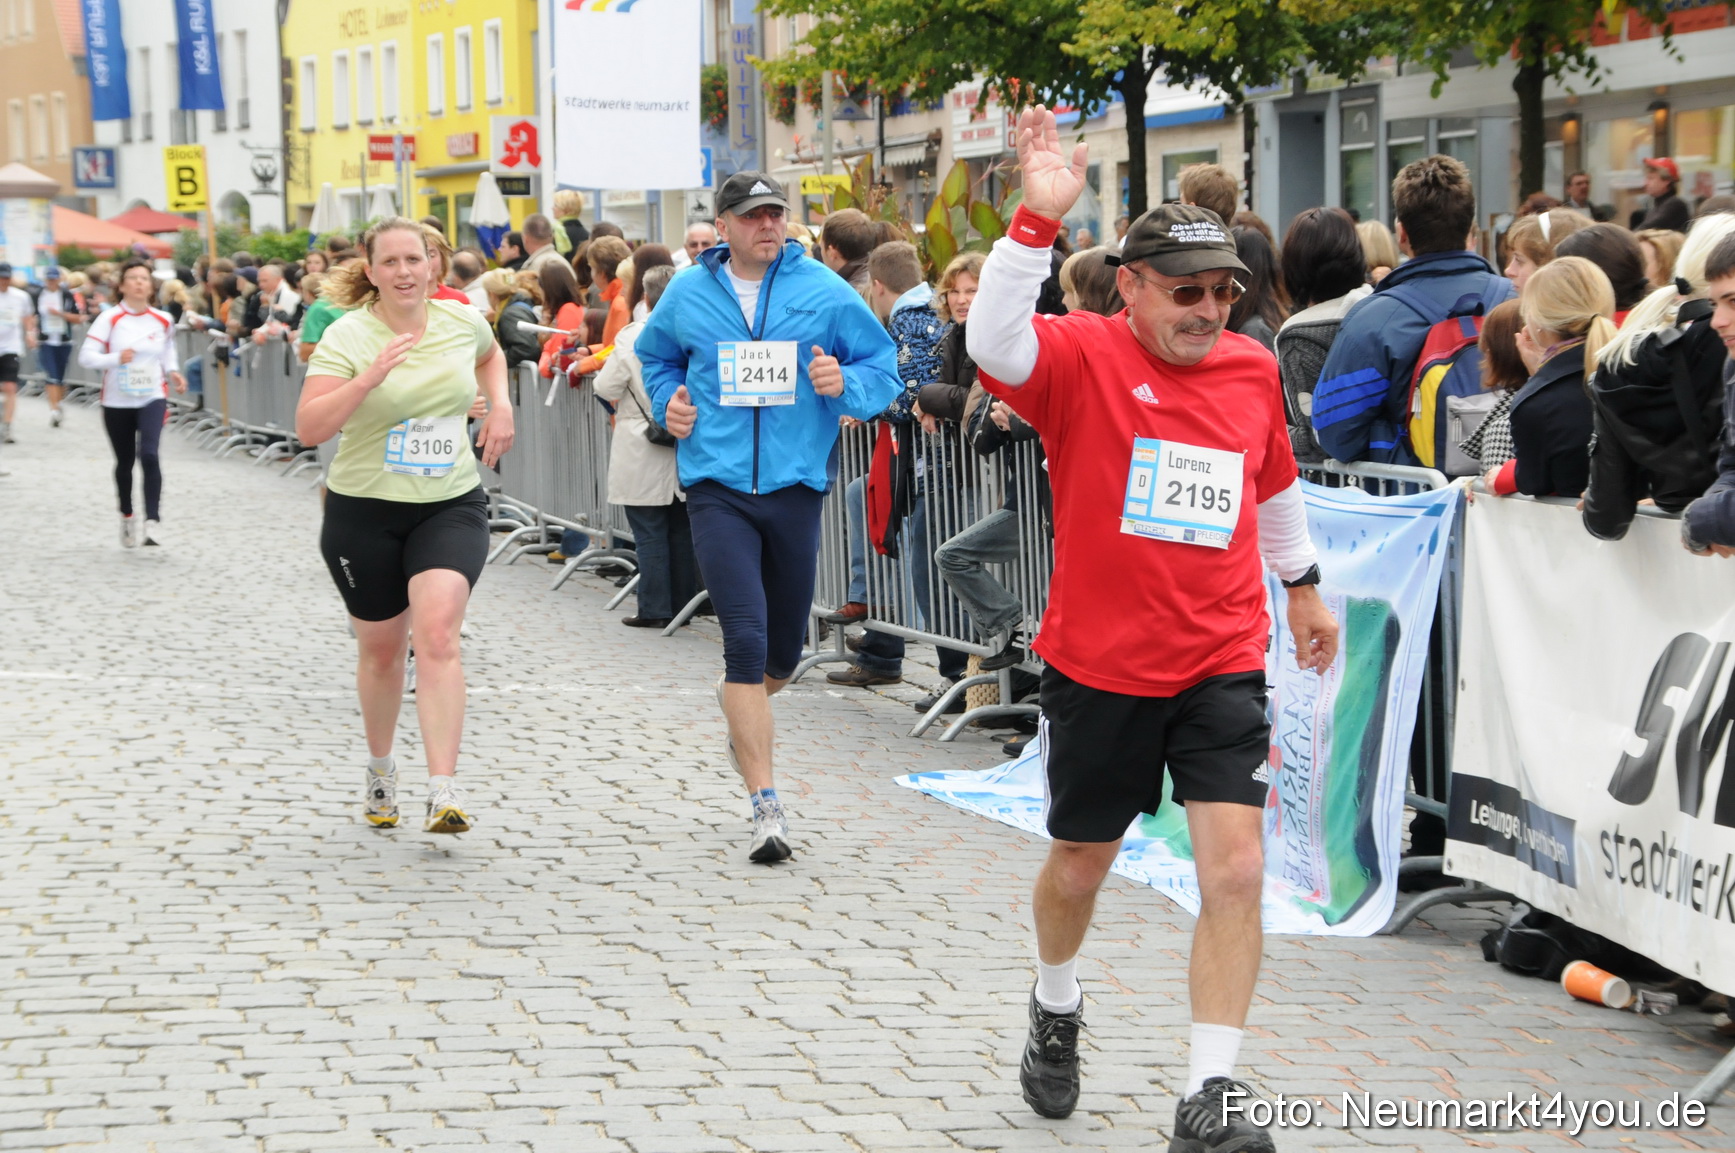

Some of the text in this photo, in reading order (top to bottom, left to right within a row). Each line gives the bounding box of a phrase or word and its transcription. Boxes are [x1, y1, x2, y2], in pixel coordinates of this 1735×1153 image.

[564, 96, 690, 112] stadtwerke neumarkt
[166, 148, 202, 161] Block
[176, 166, 198, 196] B
[741, 348, 771, 360] Jack
[742, 366, 789, 383] 2414
[411, 424, 434, 433] Karin
[410, 439, 453, 455] 3106
[1168, 450, 1212, 474] Lorenz
[1138, 474, 1147, 488] D
[1164, 480, 1232, 513] 2195
